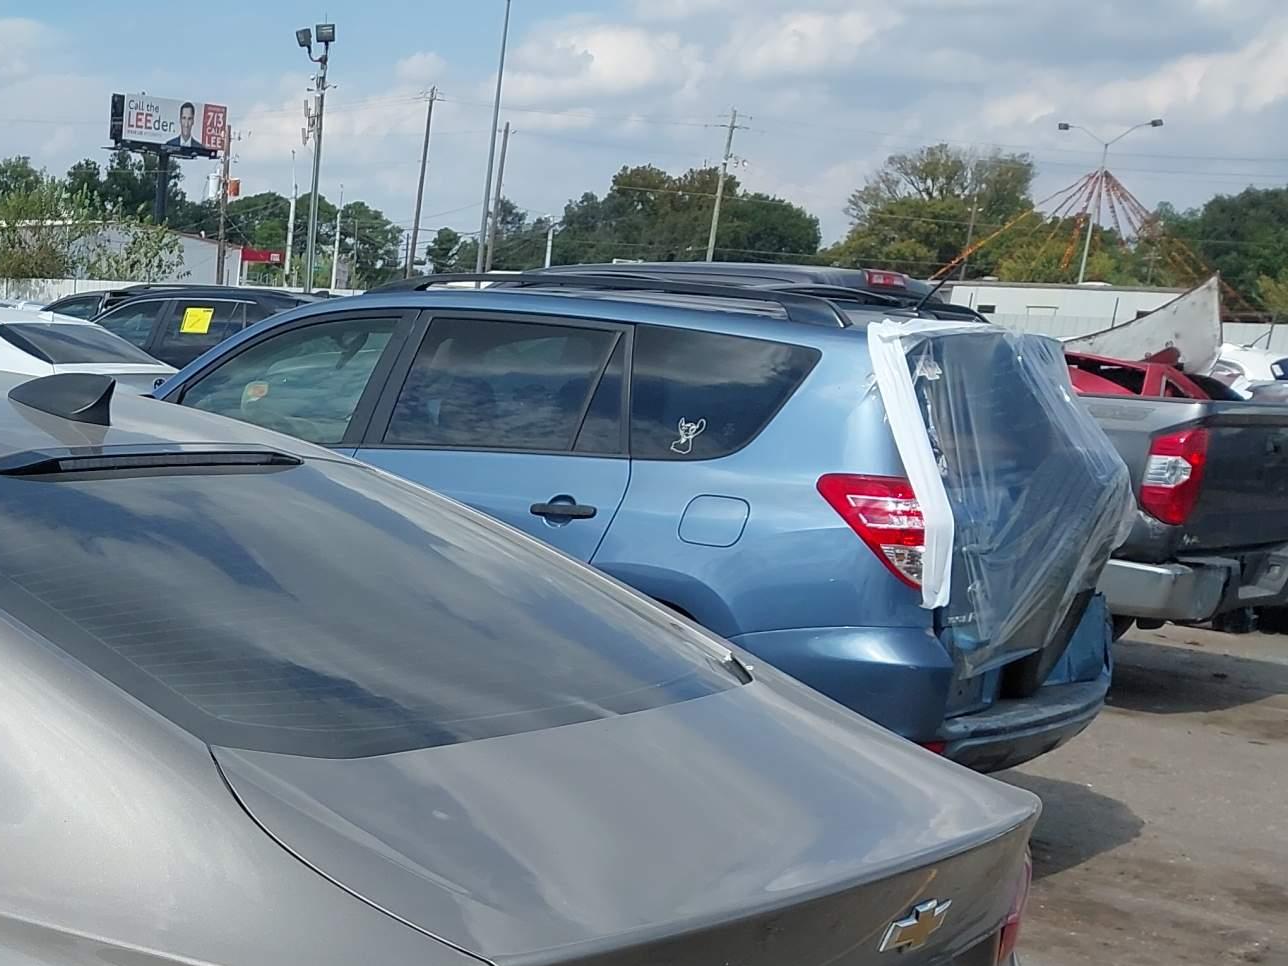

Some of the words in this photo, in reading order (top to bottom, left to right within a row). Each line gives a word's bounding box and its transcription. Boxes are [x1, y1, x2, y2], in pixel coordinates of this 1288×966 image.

[128, 99, 145, 111] Call
[146, 101, 160, 113] the
[206, 111, 224, 128] 713
